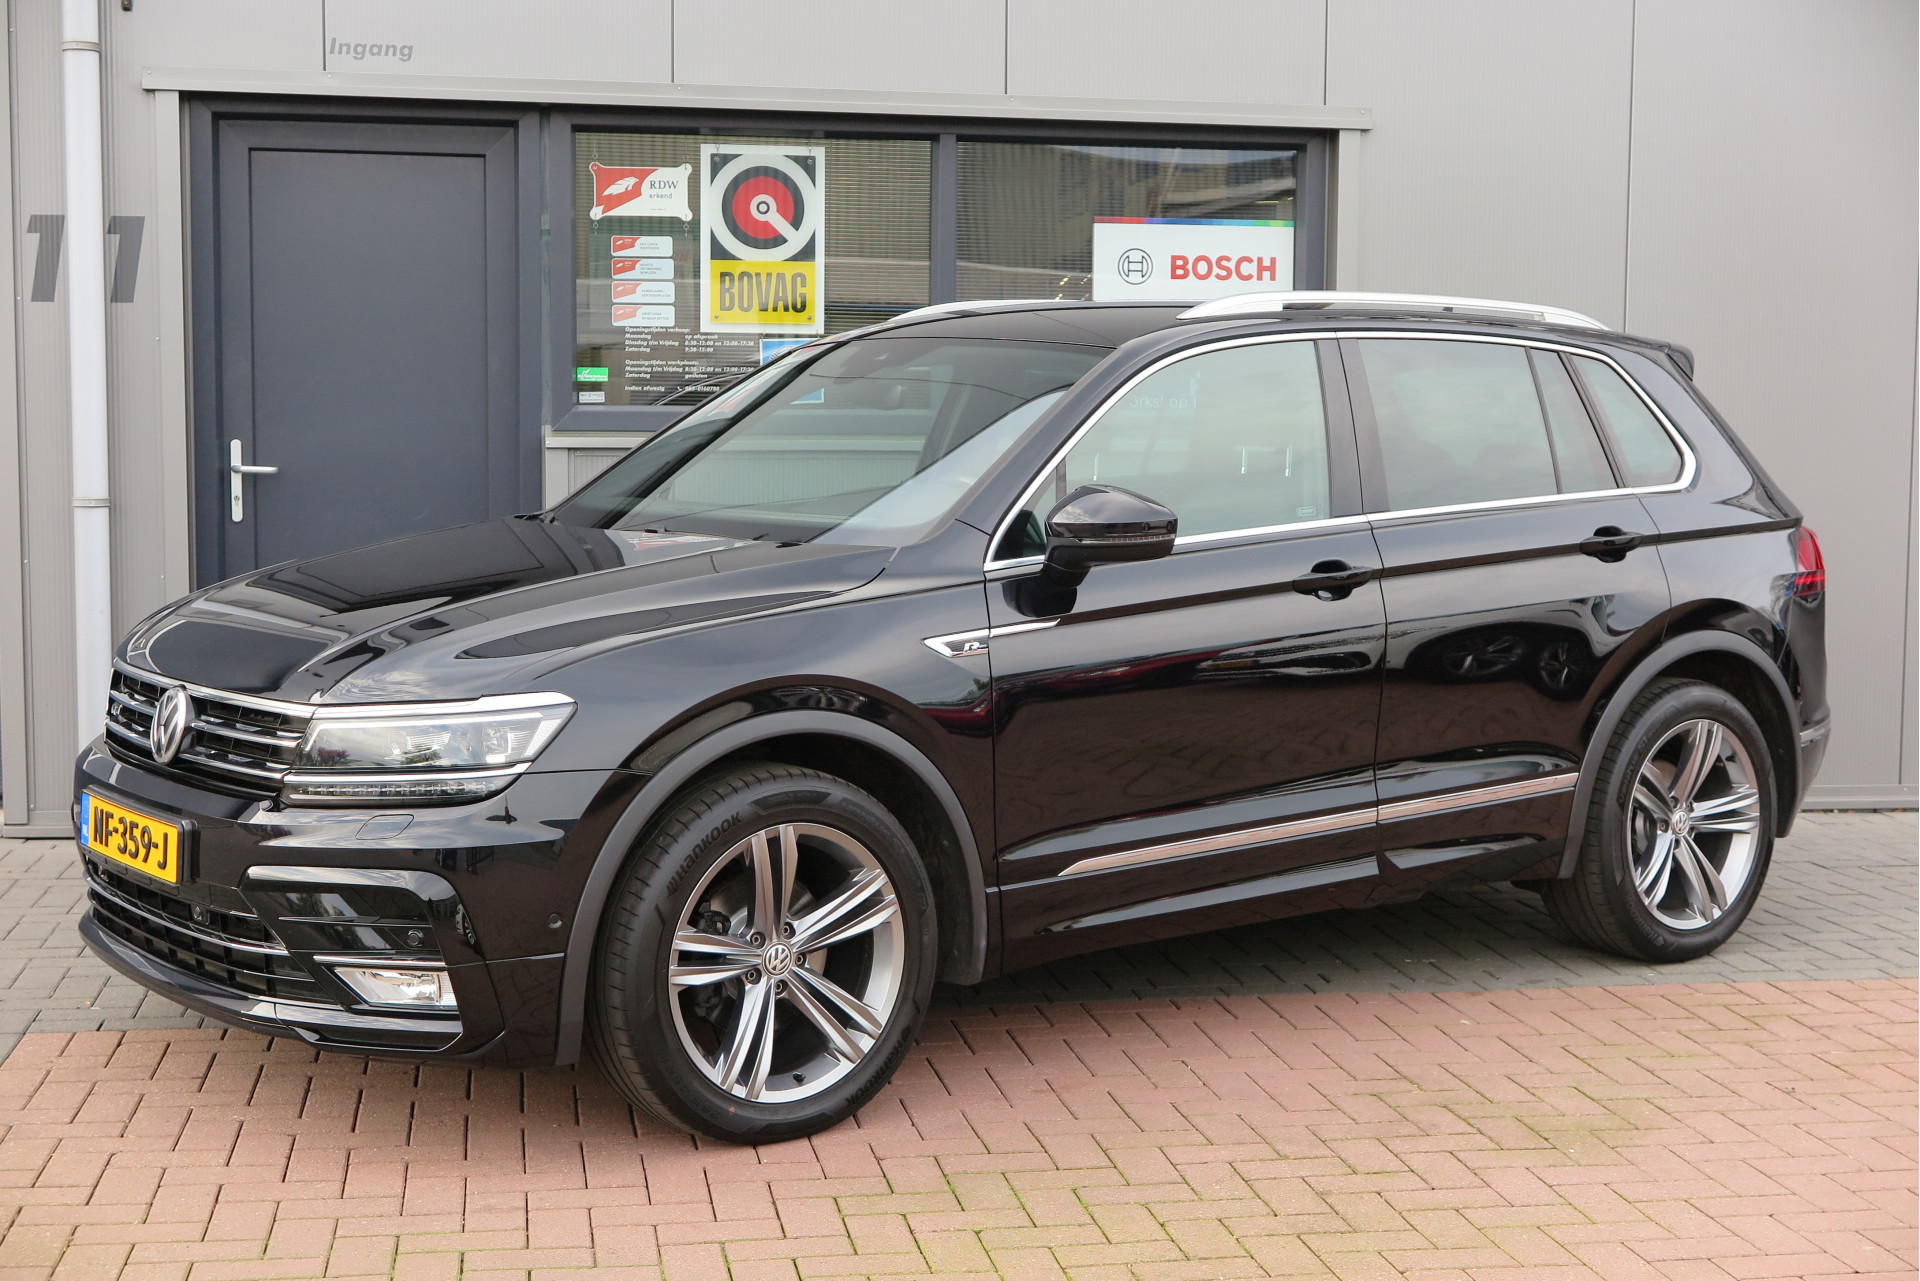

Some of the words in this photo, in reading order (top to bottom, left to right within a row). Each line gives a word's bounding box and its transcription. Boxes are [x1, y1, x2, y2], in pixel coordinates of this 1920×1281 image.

[329, 37, 414, 62] Ingang
[649, 180, 678, 190] RDW
[1170, 255, 1277, 281] BOSCH
[719, 271, 807, 313] BOVAG
[93, 805, 169, 871] NF-359-J
